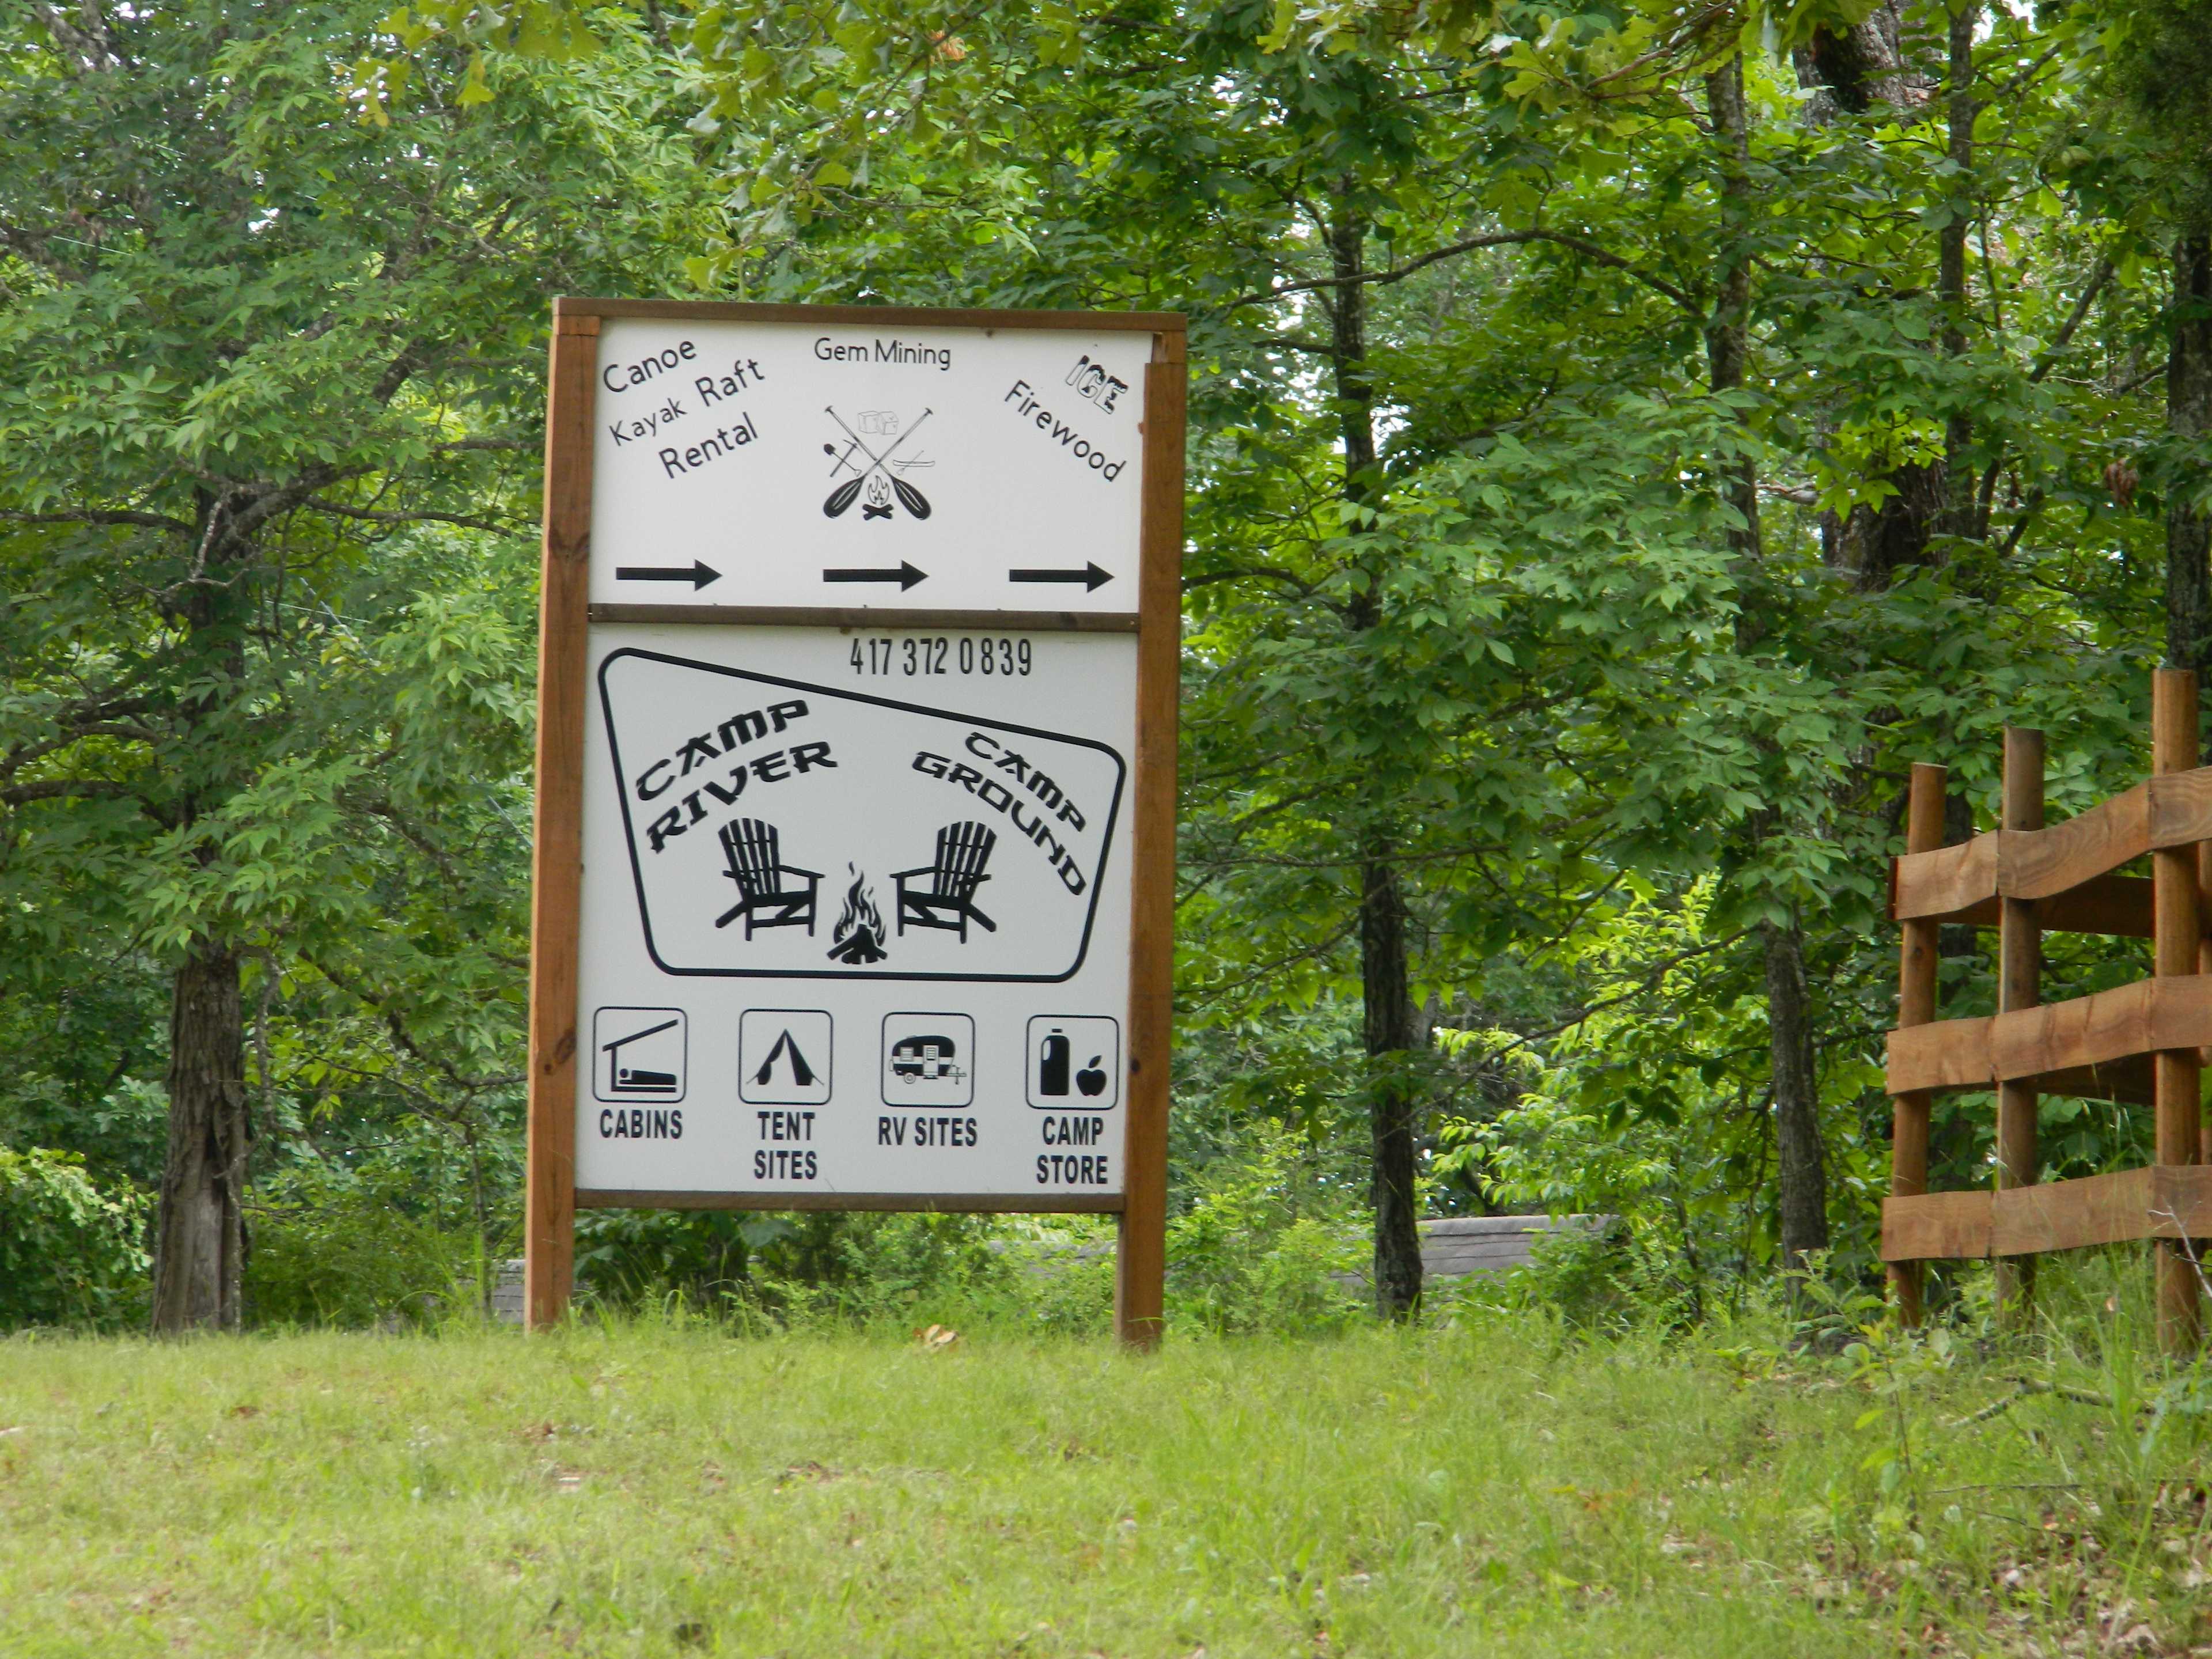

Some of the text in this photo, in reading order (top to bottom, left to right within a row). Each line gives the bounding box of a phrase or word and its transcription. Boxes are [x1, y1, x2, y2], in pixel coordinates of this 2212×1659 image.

[603, 341, 696, 393] Canoe
[814, 337, 950, 371] Gem Mining
[609, 358, 764, 446] Kayak Raft
[1065, 355, 1128, 414] ICE
[658, 412, 757, 479] Rental
[1005, 380, 1127, 482] Firewood
[850, 637, 1032, 676] 417 372 0839
[635, 699, 809, 801] CAMP
[646, 741, 839, 854] RIVER
[964, 732, 1086, 832] CAMP
[911, 751, 1087, 896] GROUND
[600, 1108, 683, 1139] CABINS
[757, 1111, 816, 1141] TENT
[878, 1116, 978, 1147] RV SITES
[1042, 1116, 1104, 1146] CAMP
[753, 1149, 817, 1180] SITES
[1036, 1154, 1108, 1185] STORE
